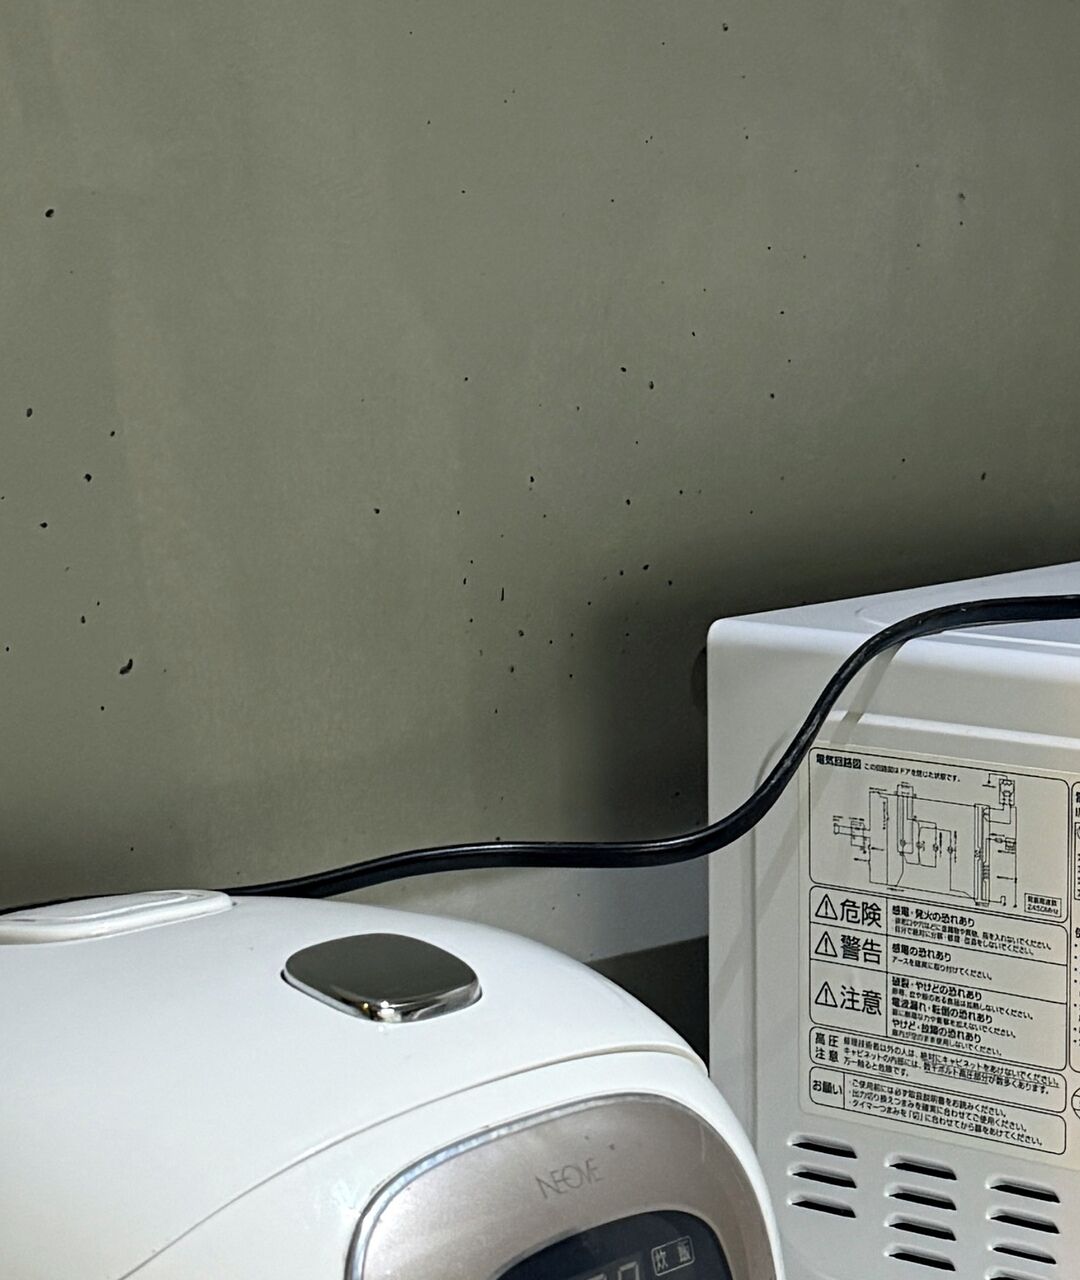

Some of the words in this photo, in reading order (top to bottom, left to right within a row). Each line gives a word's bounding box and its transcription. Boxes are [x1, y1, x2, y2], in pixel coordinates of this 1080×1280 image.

[816, 753, 860, 769] 電気回路図
[840, 897, 881, 928] 危険
[840, 934, 881, 965] 警告
[892, 943, 951, 962] 感電の恐れあり
[840, 984, 881, 1015] 注意
[812, 1078, 842, 1096] お願い
